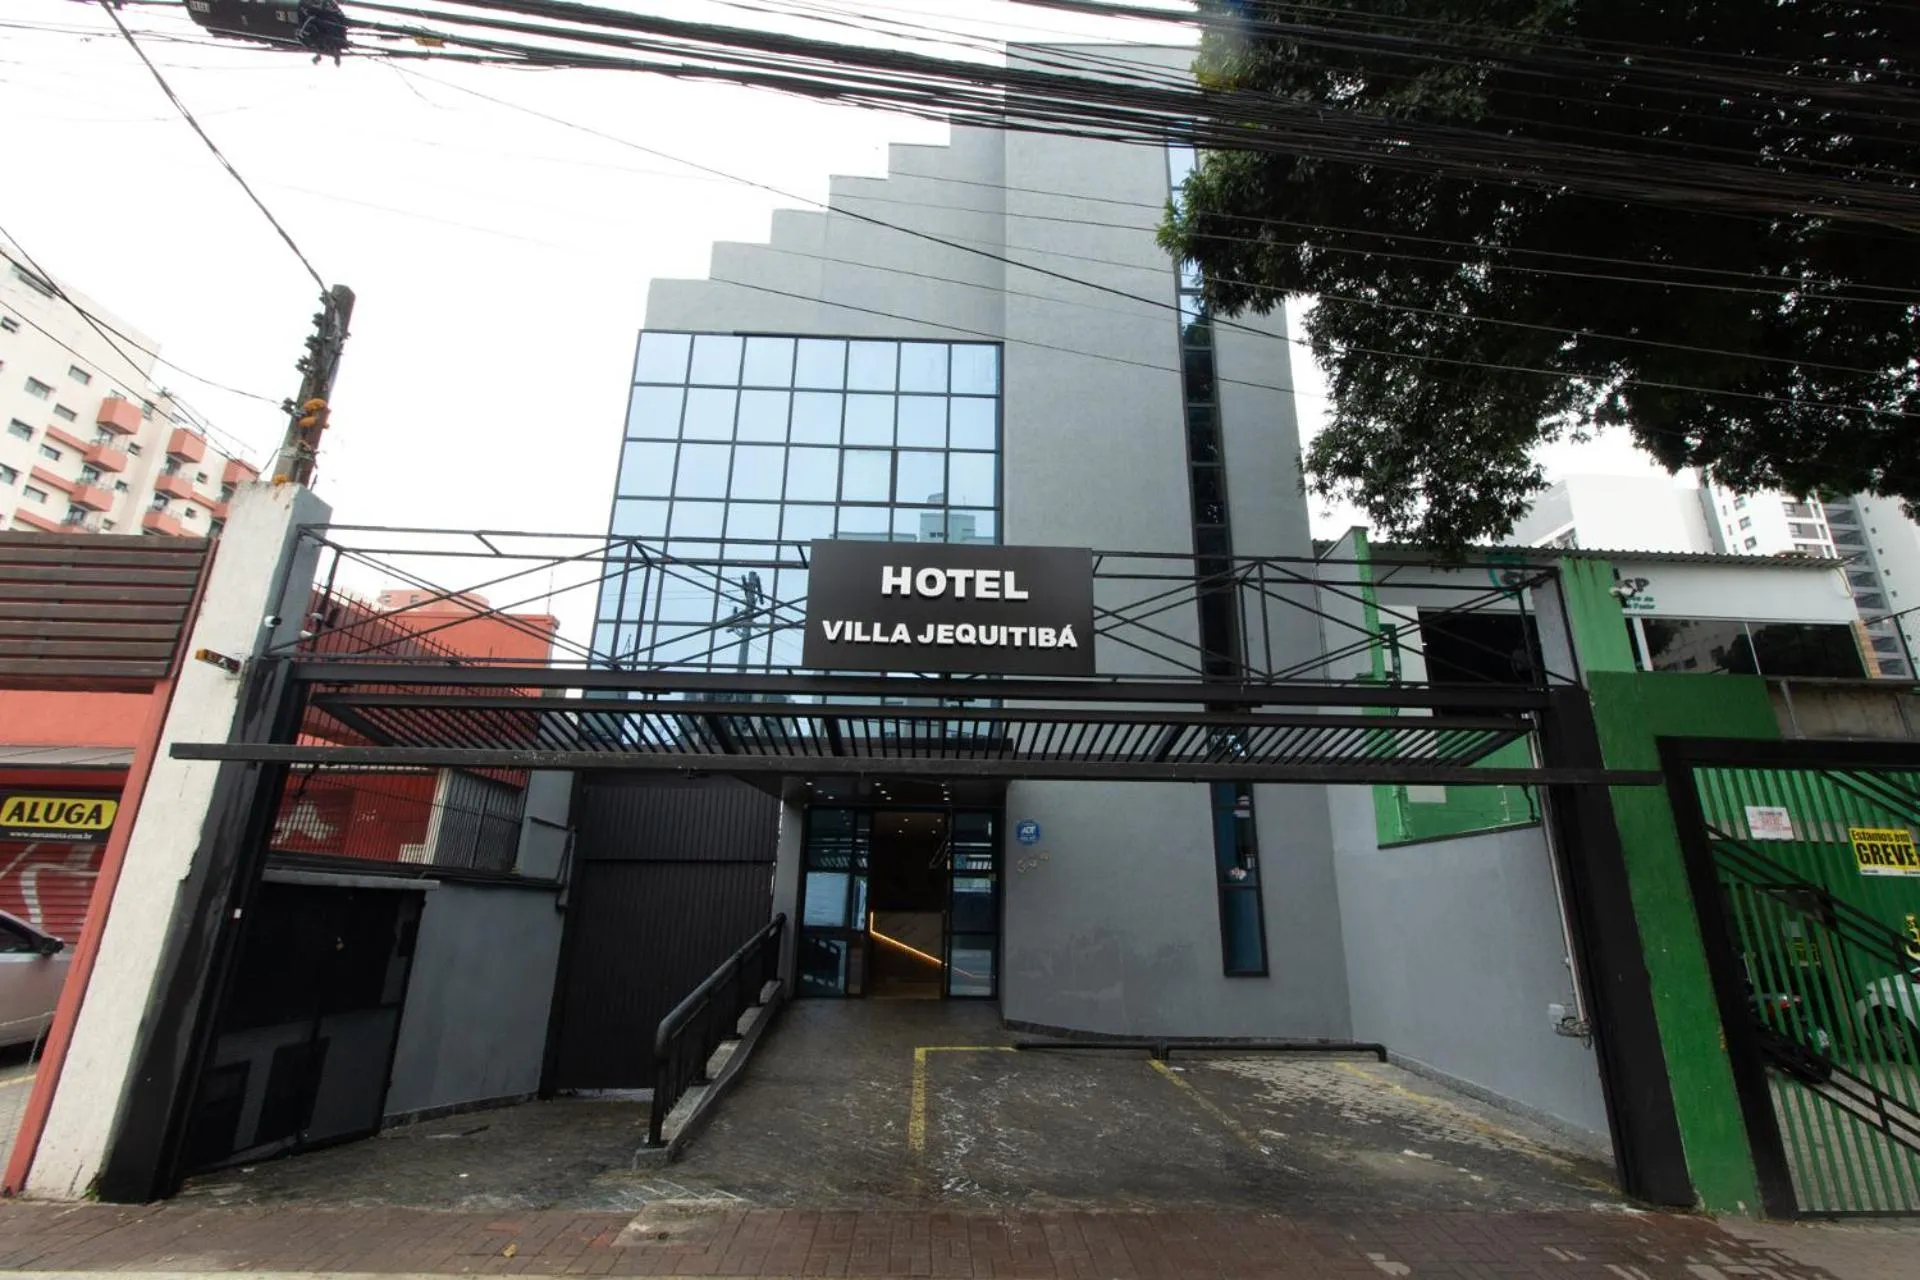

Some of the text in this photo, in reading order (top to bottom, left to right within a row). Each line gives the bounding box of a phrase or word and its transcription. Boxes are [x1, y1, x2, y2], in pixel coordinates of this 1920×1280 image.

[881, 566, 1029, 600] HOTEL
[822, 620, 1078, 648] VILLA JEQUITIBÁ
[5, 801, 102, 825] ALUGA
[1856, 843, 1917, 865] GREVE
